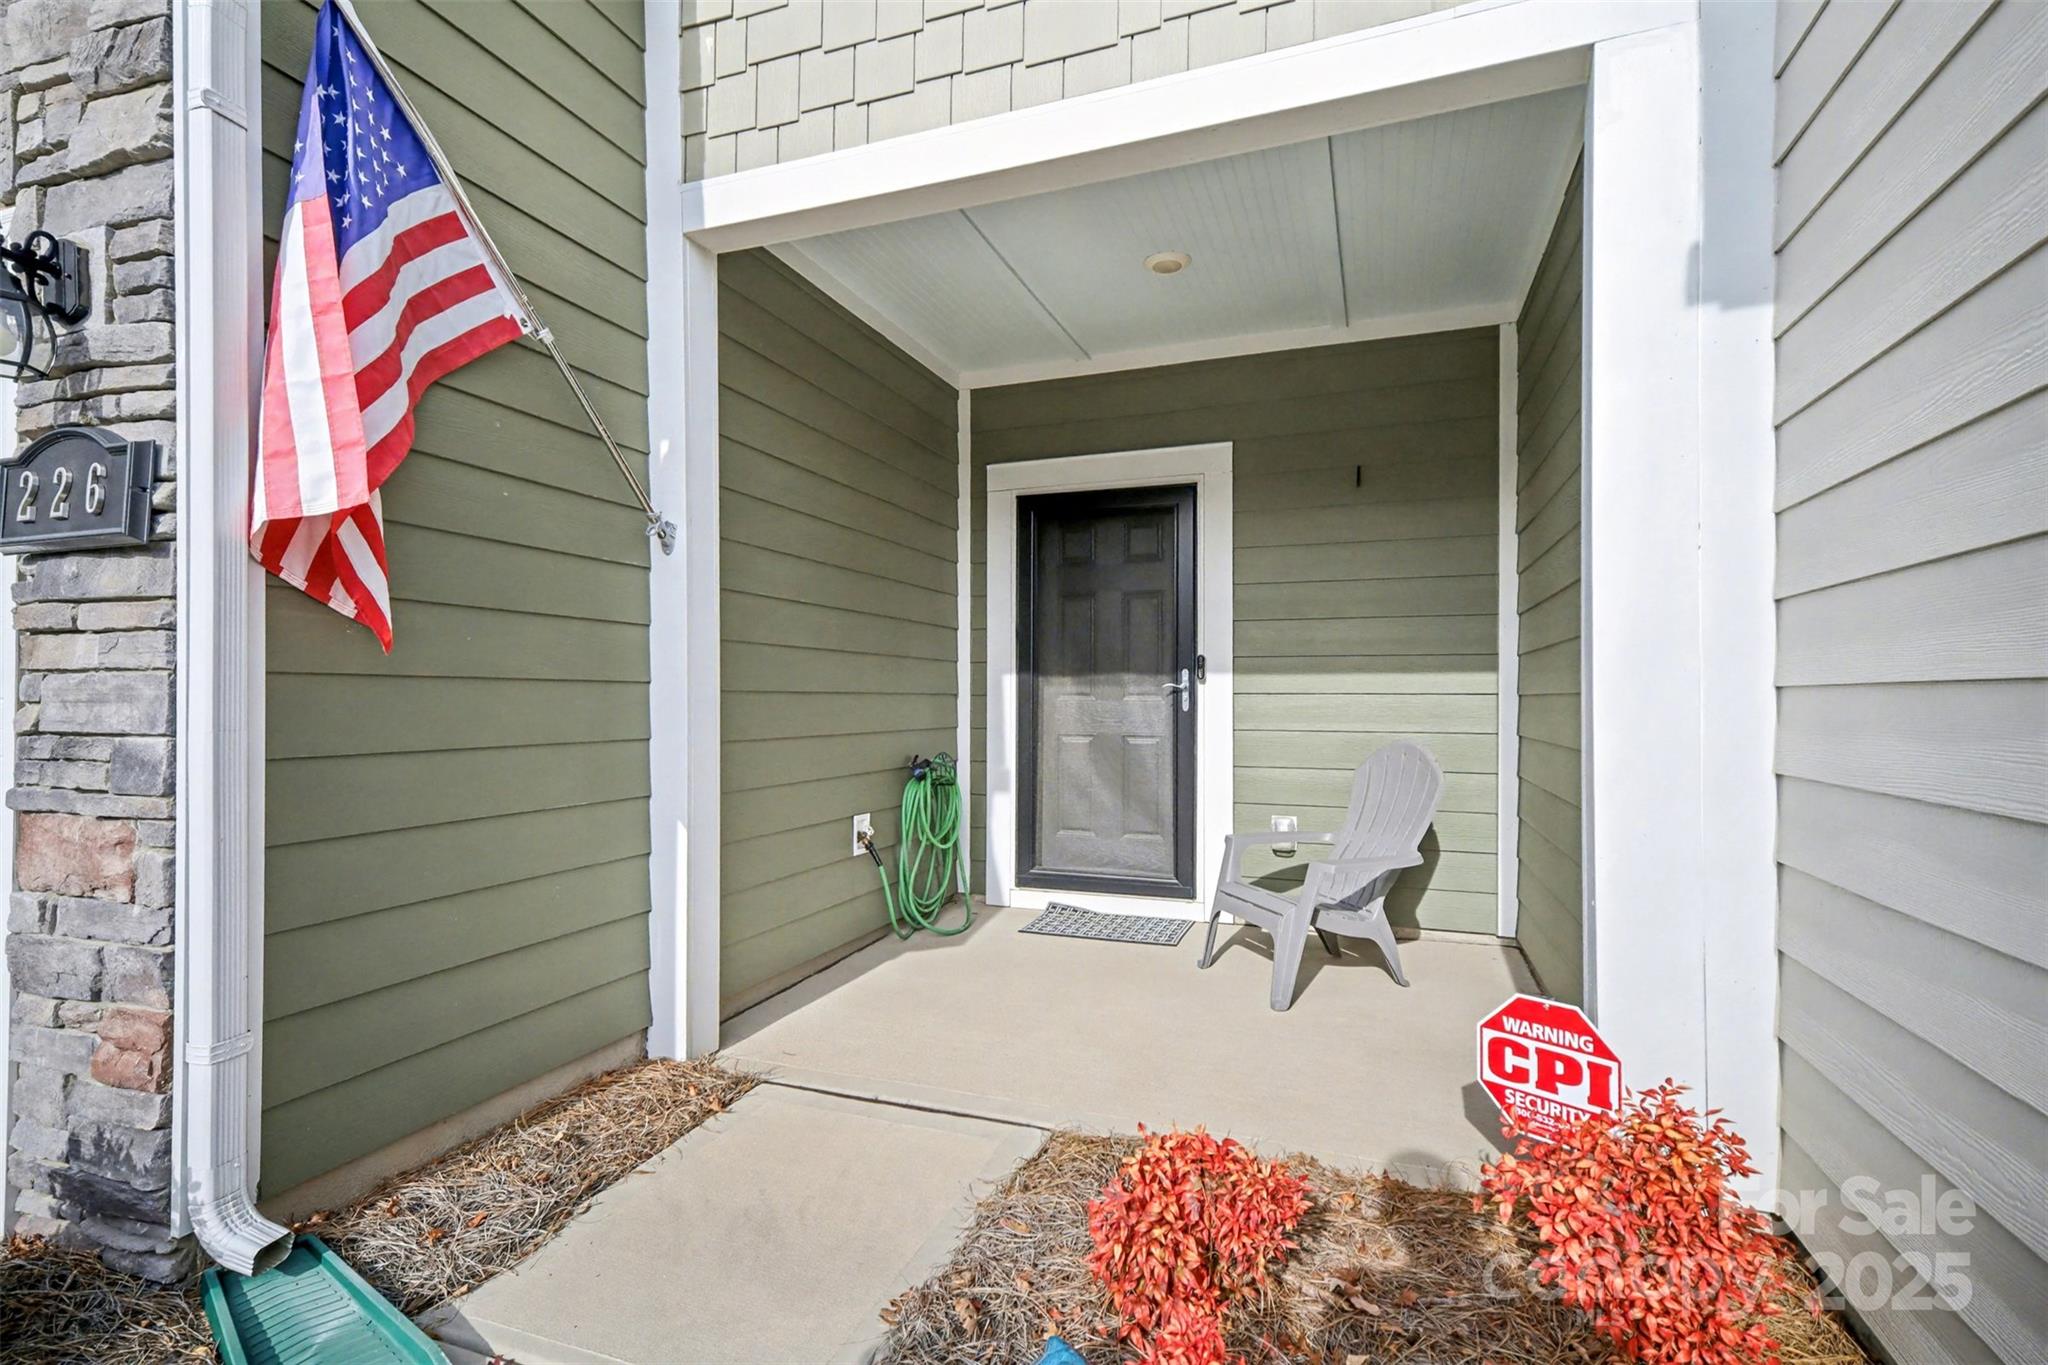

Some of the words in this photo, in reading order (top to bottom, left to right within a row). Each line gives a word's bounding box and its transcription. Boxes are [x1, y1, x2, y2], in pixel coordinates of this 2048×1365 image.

[16, 462, 107, 523] 226
[1502, 1015, 1594, 1053] WARNING
[1488, 1036, 1613, 1110] CPI
[1504, 1089, 1592, 1124] SECURITY
